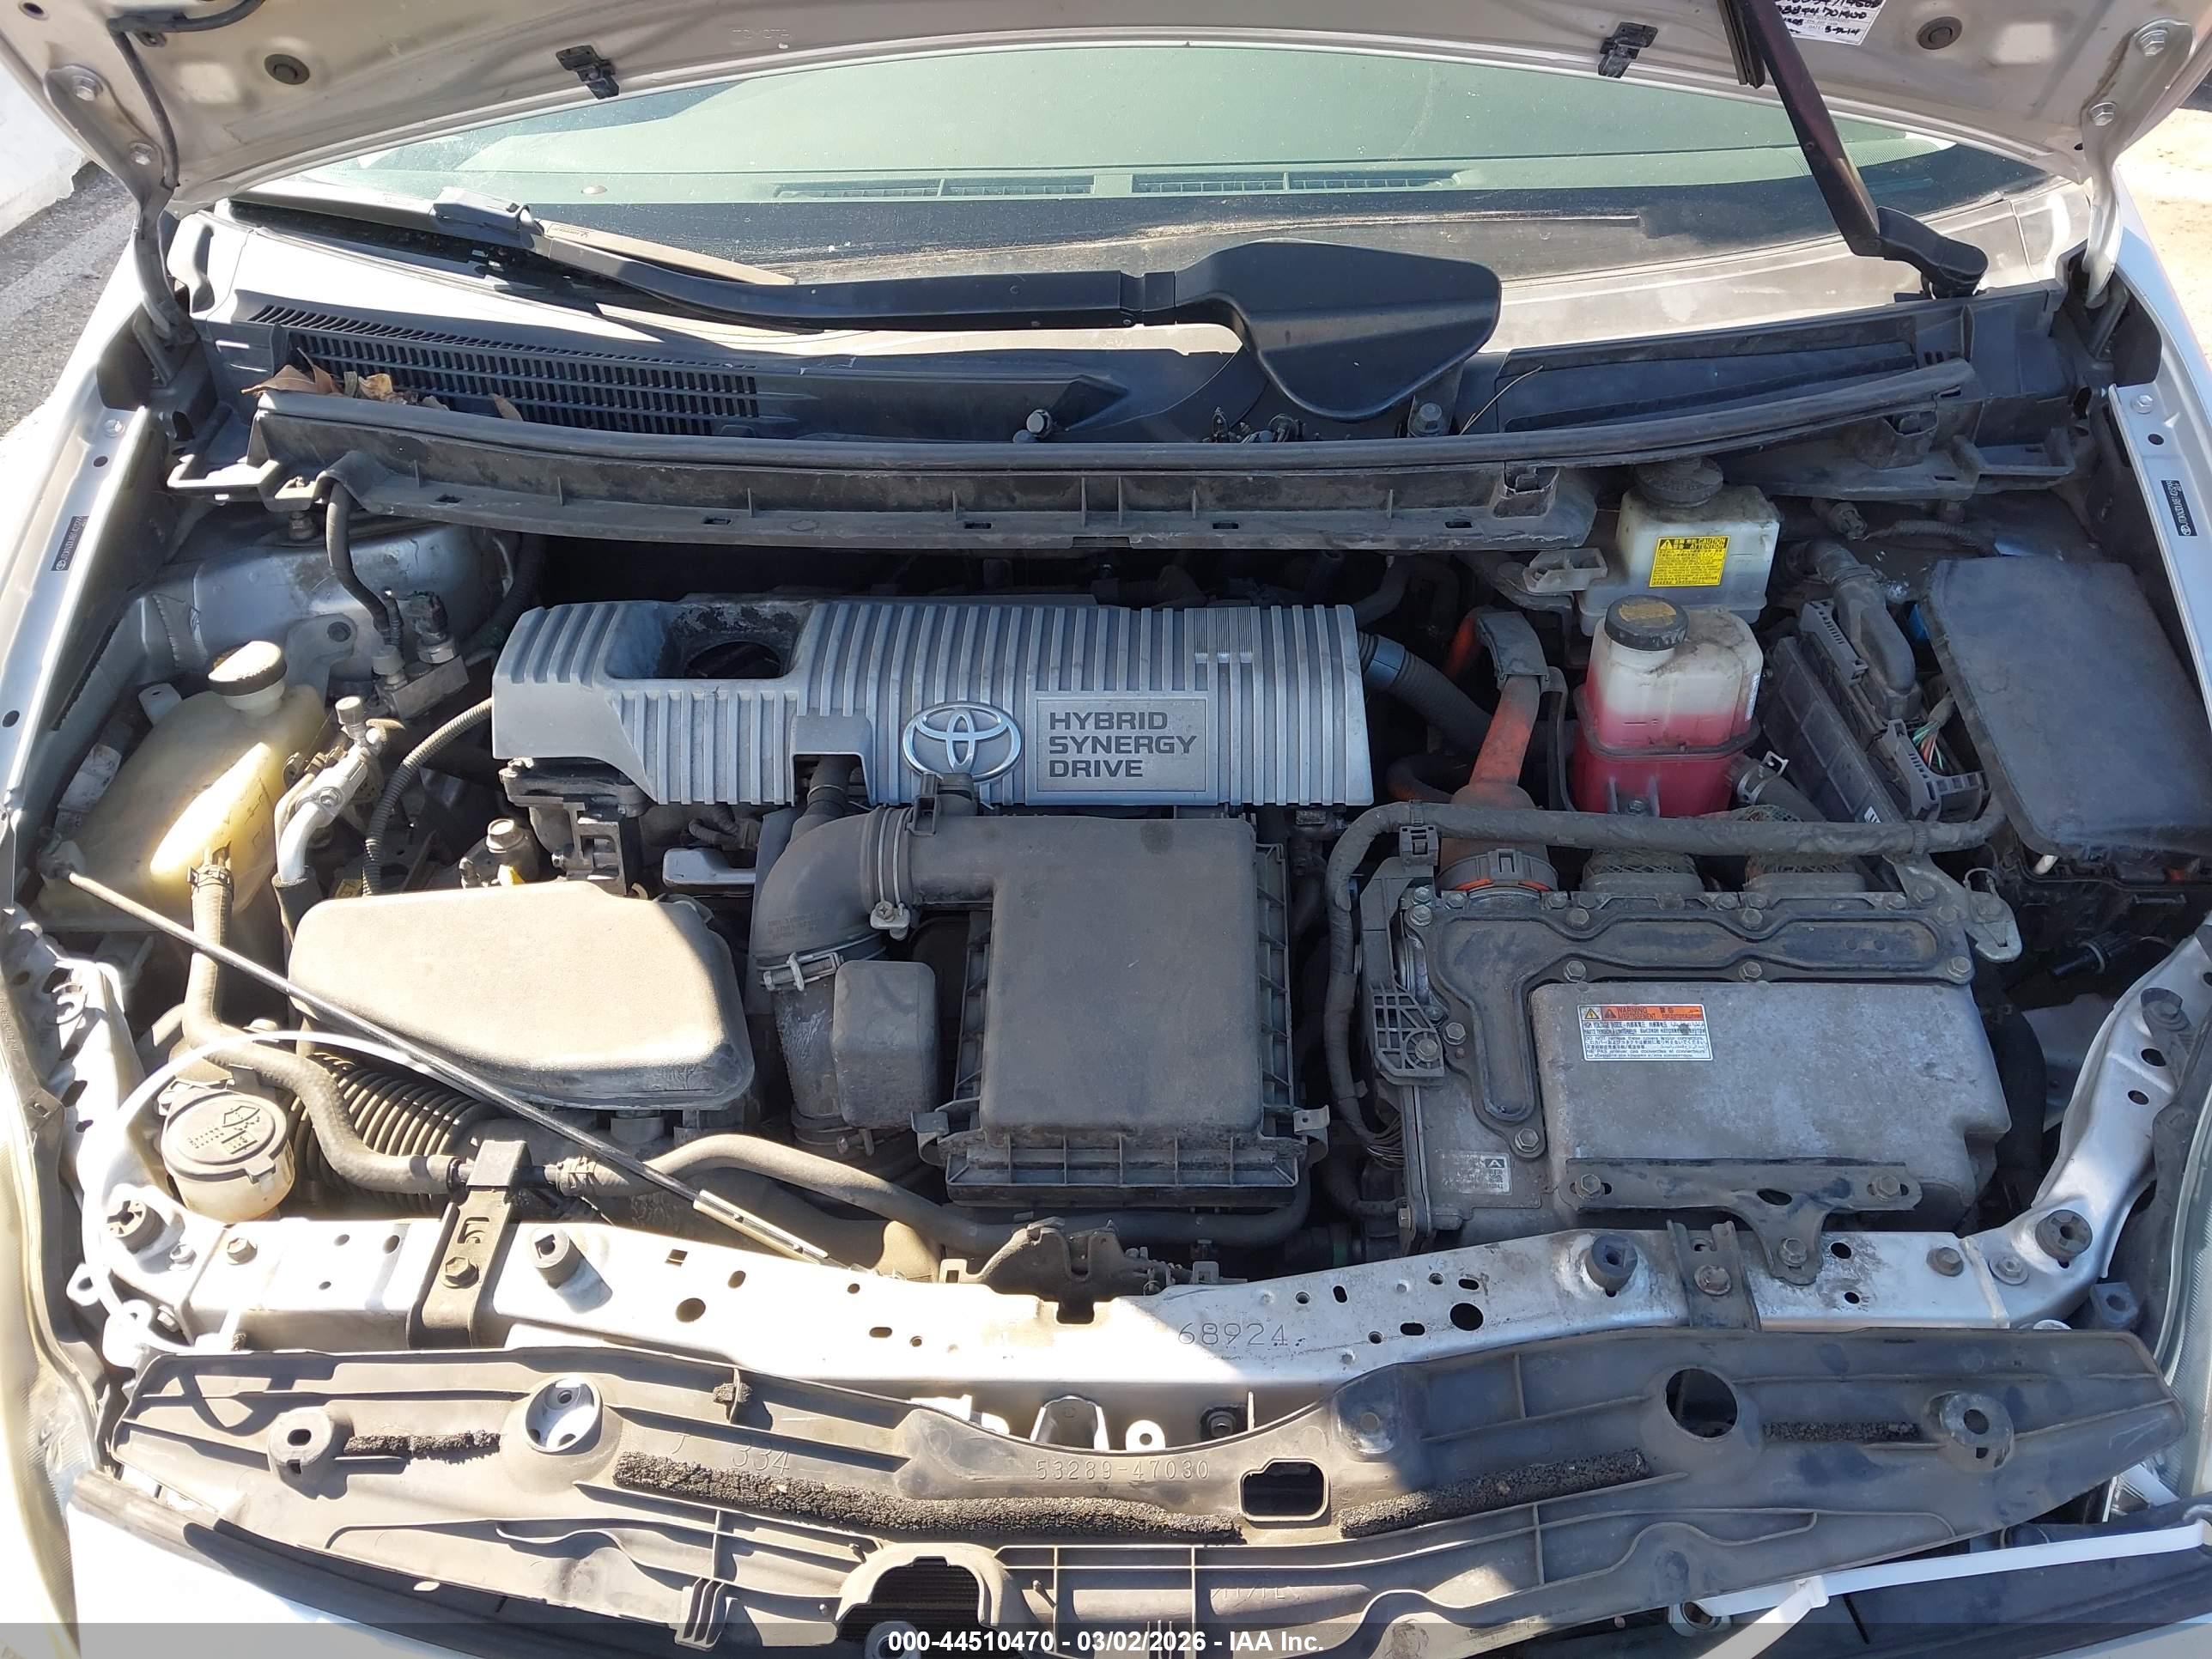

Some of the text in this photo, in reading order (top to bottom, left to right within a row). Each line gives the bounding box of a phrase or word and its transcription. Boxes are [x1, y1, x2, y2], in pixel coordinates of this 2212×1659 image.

[1049, 712, 1168, 730] HYBRID
[1049, 735, 1198, 754] SYNERGY
[1049, 760, 1143, 777] DRIVE
[1178, 1322, 1289, 1346] 68924
[731, 1437, 790, 1475] 334
[1036, 1460, 1210, 1480] 53289-47030
